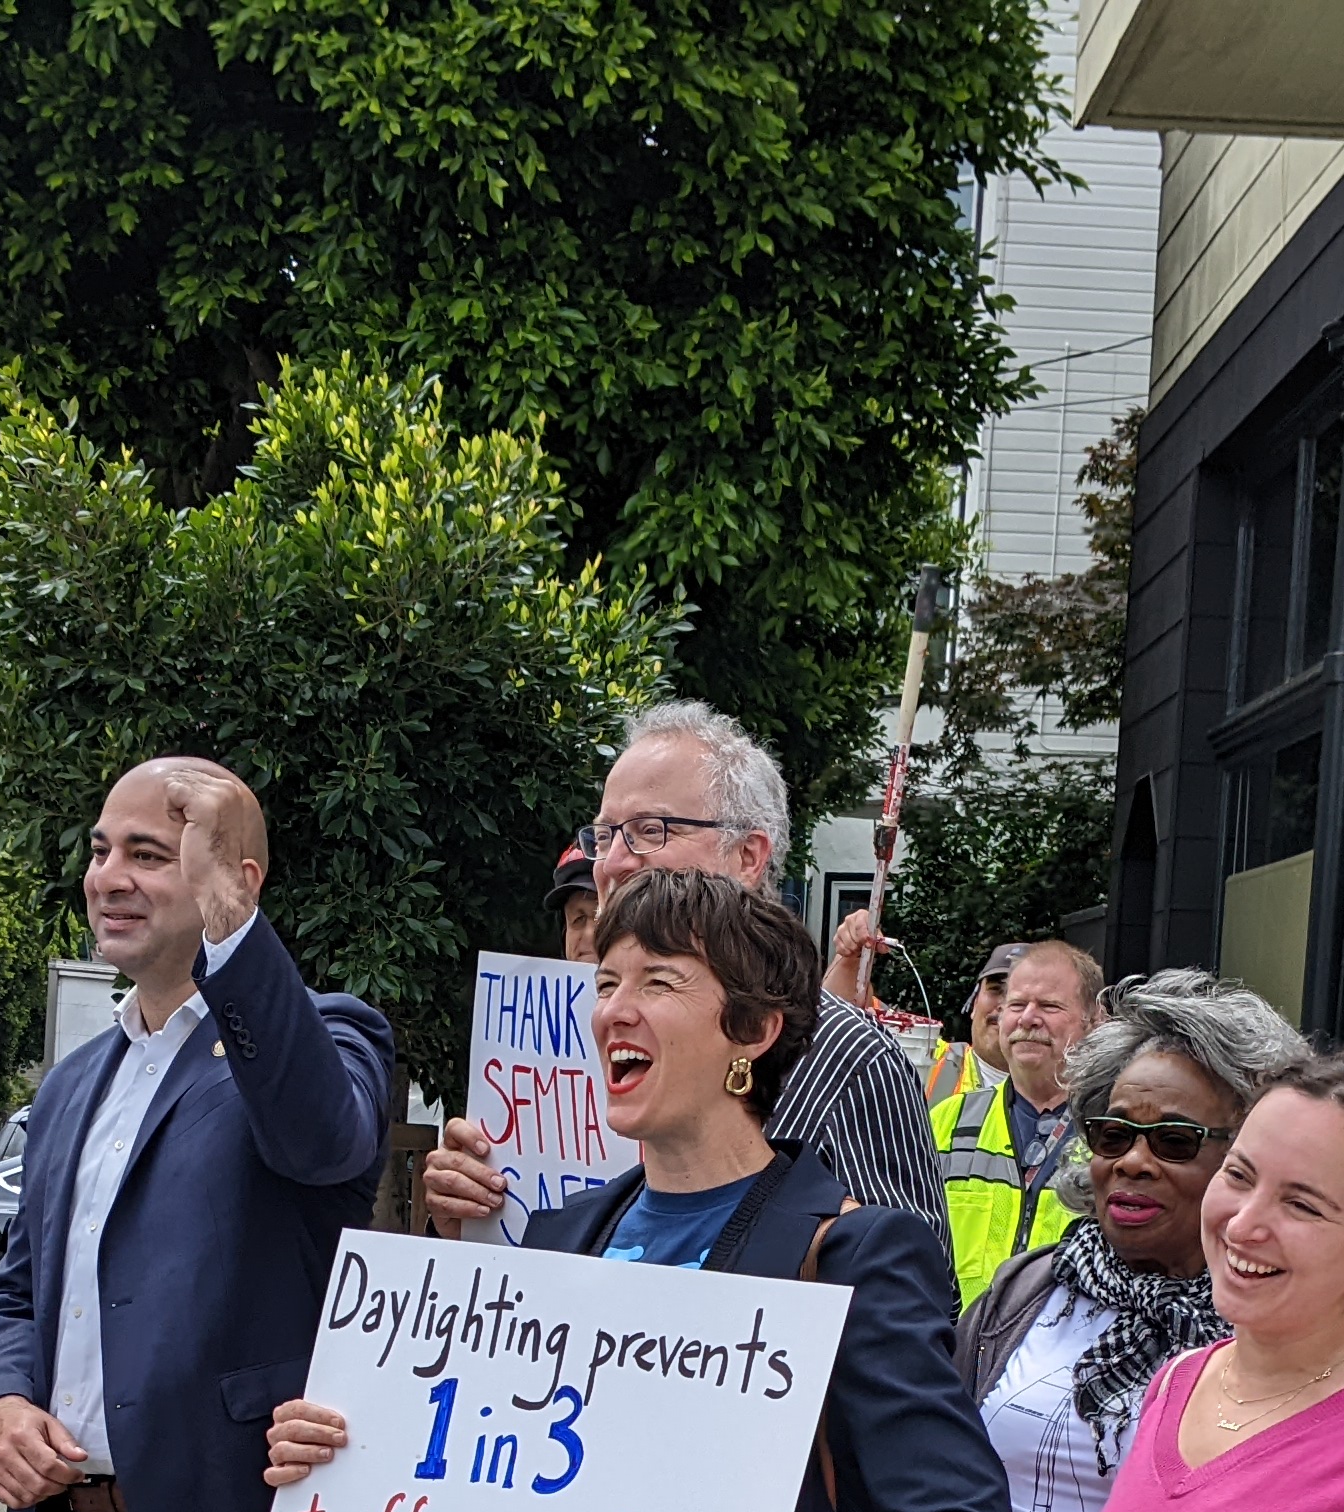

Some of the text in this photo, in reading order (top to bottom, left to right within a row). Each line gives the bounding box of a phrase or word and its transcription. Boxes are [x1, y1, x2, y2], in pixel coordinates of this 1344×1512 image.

[480, 971, 587, 1060] THANK
[480, 1058, 606, 1167] SFMTA
[328, 1251, 794, 1411] Daylighting prevents
[414, 1378, 585, 1494] 1 in 3
